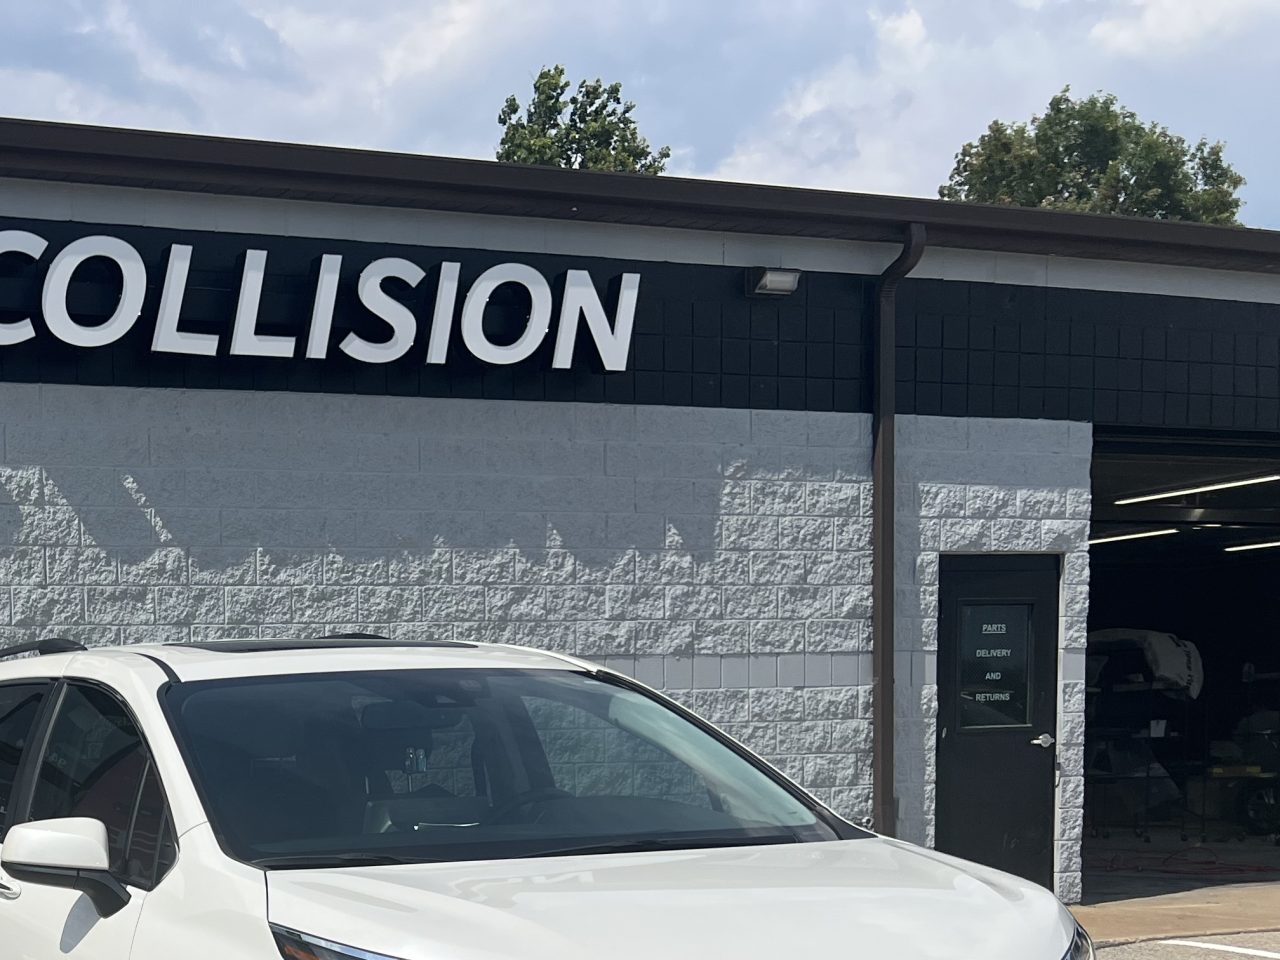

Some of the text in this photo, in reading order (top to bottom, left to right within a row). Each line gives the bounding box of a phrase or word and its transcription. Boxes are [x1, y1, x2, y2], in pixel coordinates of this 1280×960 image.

[982, 624, 1007, 633] PARTS
[976, 649, 1011, 658] DELIVERY
[985, 672, 1002, 681] AND
[975, 693, 1010, 702] RETURNS
